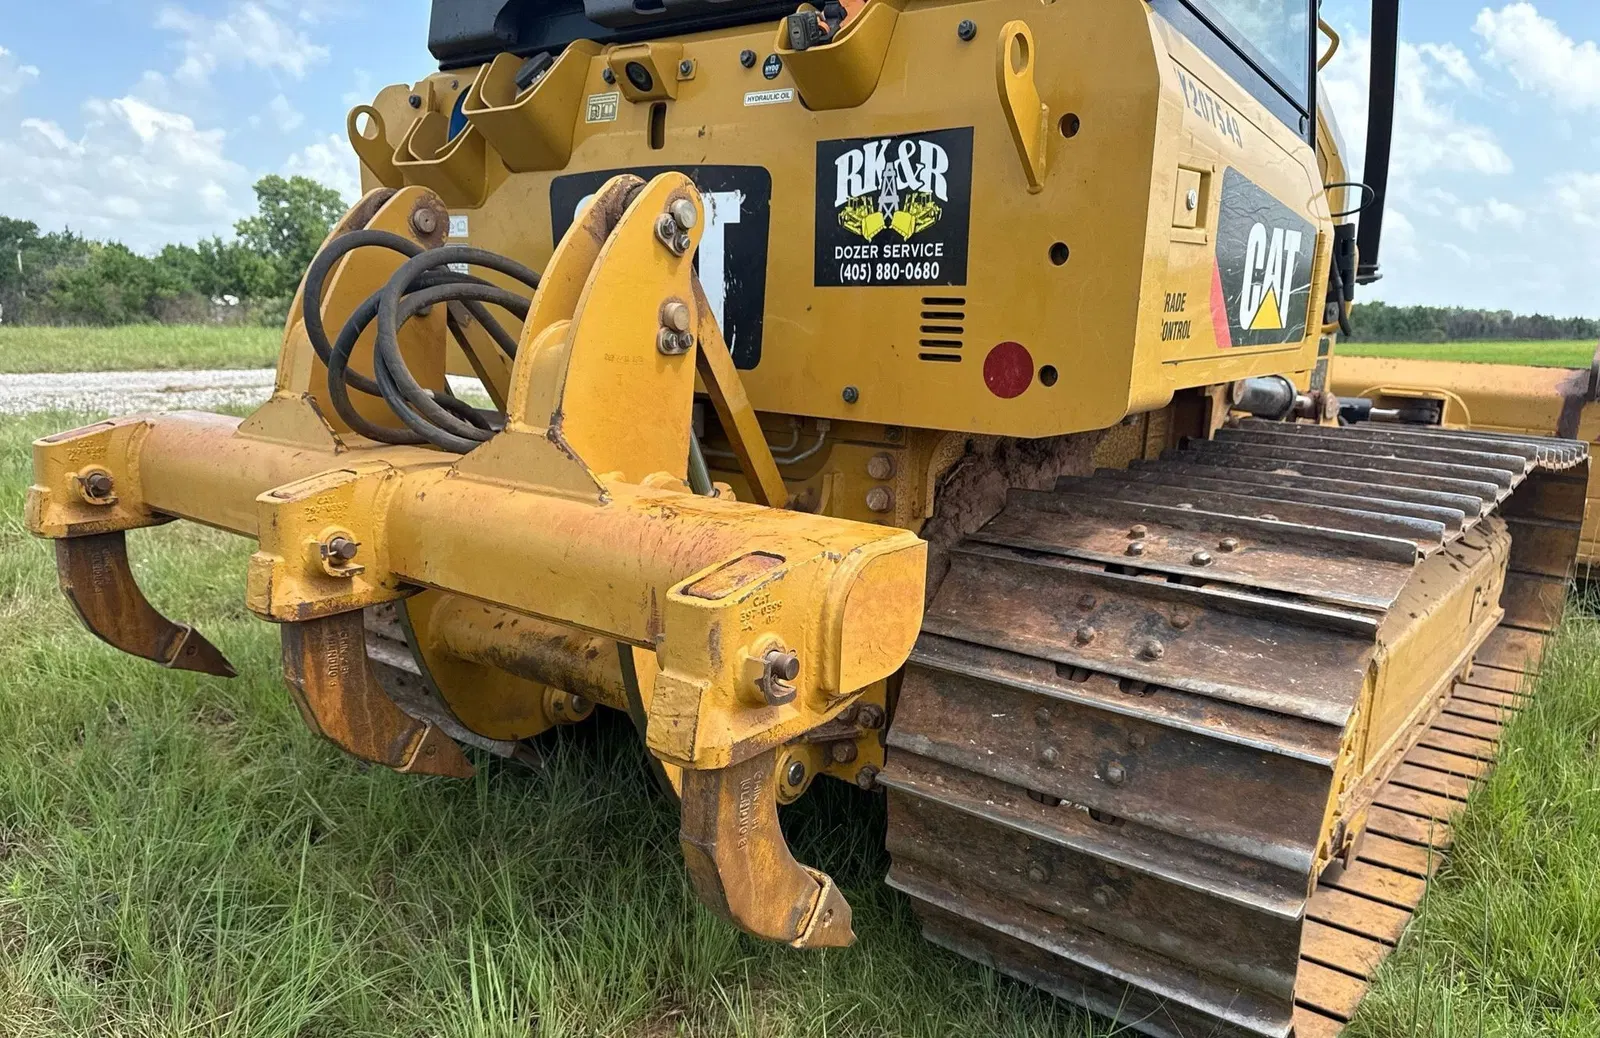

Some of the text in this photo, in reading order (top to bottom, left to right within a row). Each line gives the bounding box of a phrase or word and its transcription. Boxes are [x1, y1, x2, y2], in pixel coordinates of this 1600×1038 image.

[747, 92, 791, 103] HYDRAULIC OIL
[1173, 67, 1244, 149] Y207549
[835, 139, 949, 207] RK&R
[835, 242, 944, 260] DOZER SERVICE
[839, 261, 940, 283] (405) 880-0680
[1239, 222, 1302, 330] CAT
[1163, 290, 1187, 313] RADE
[1160, 318, 1192, 342] ONTROL
[752, 593, 771, 607] CAT
